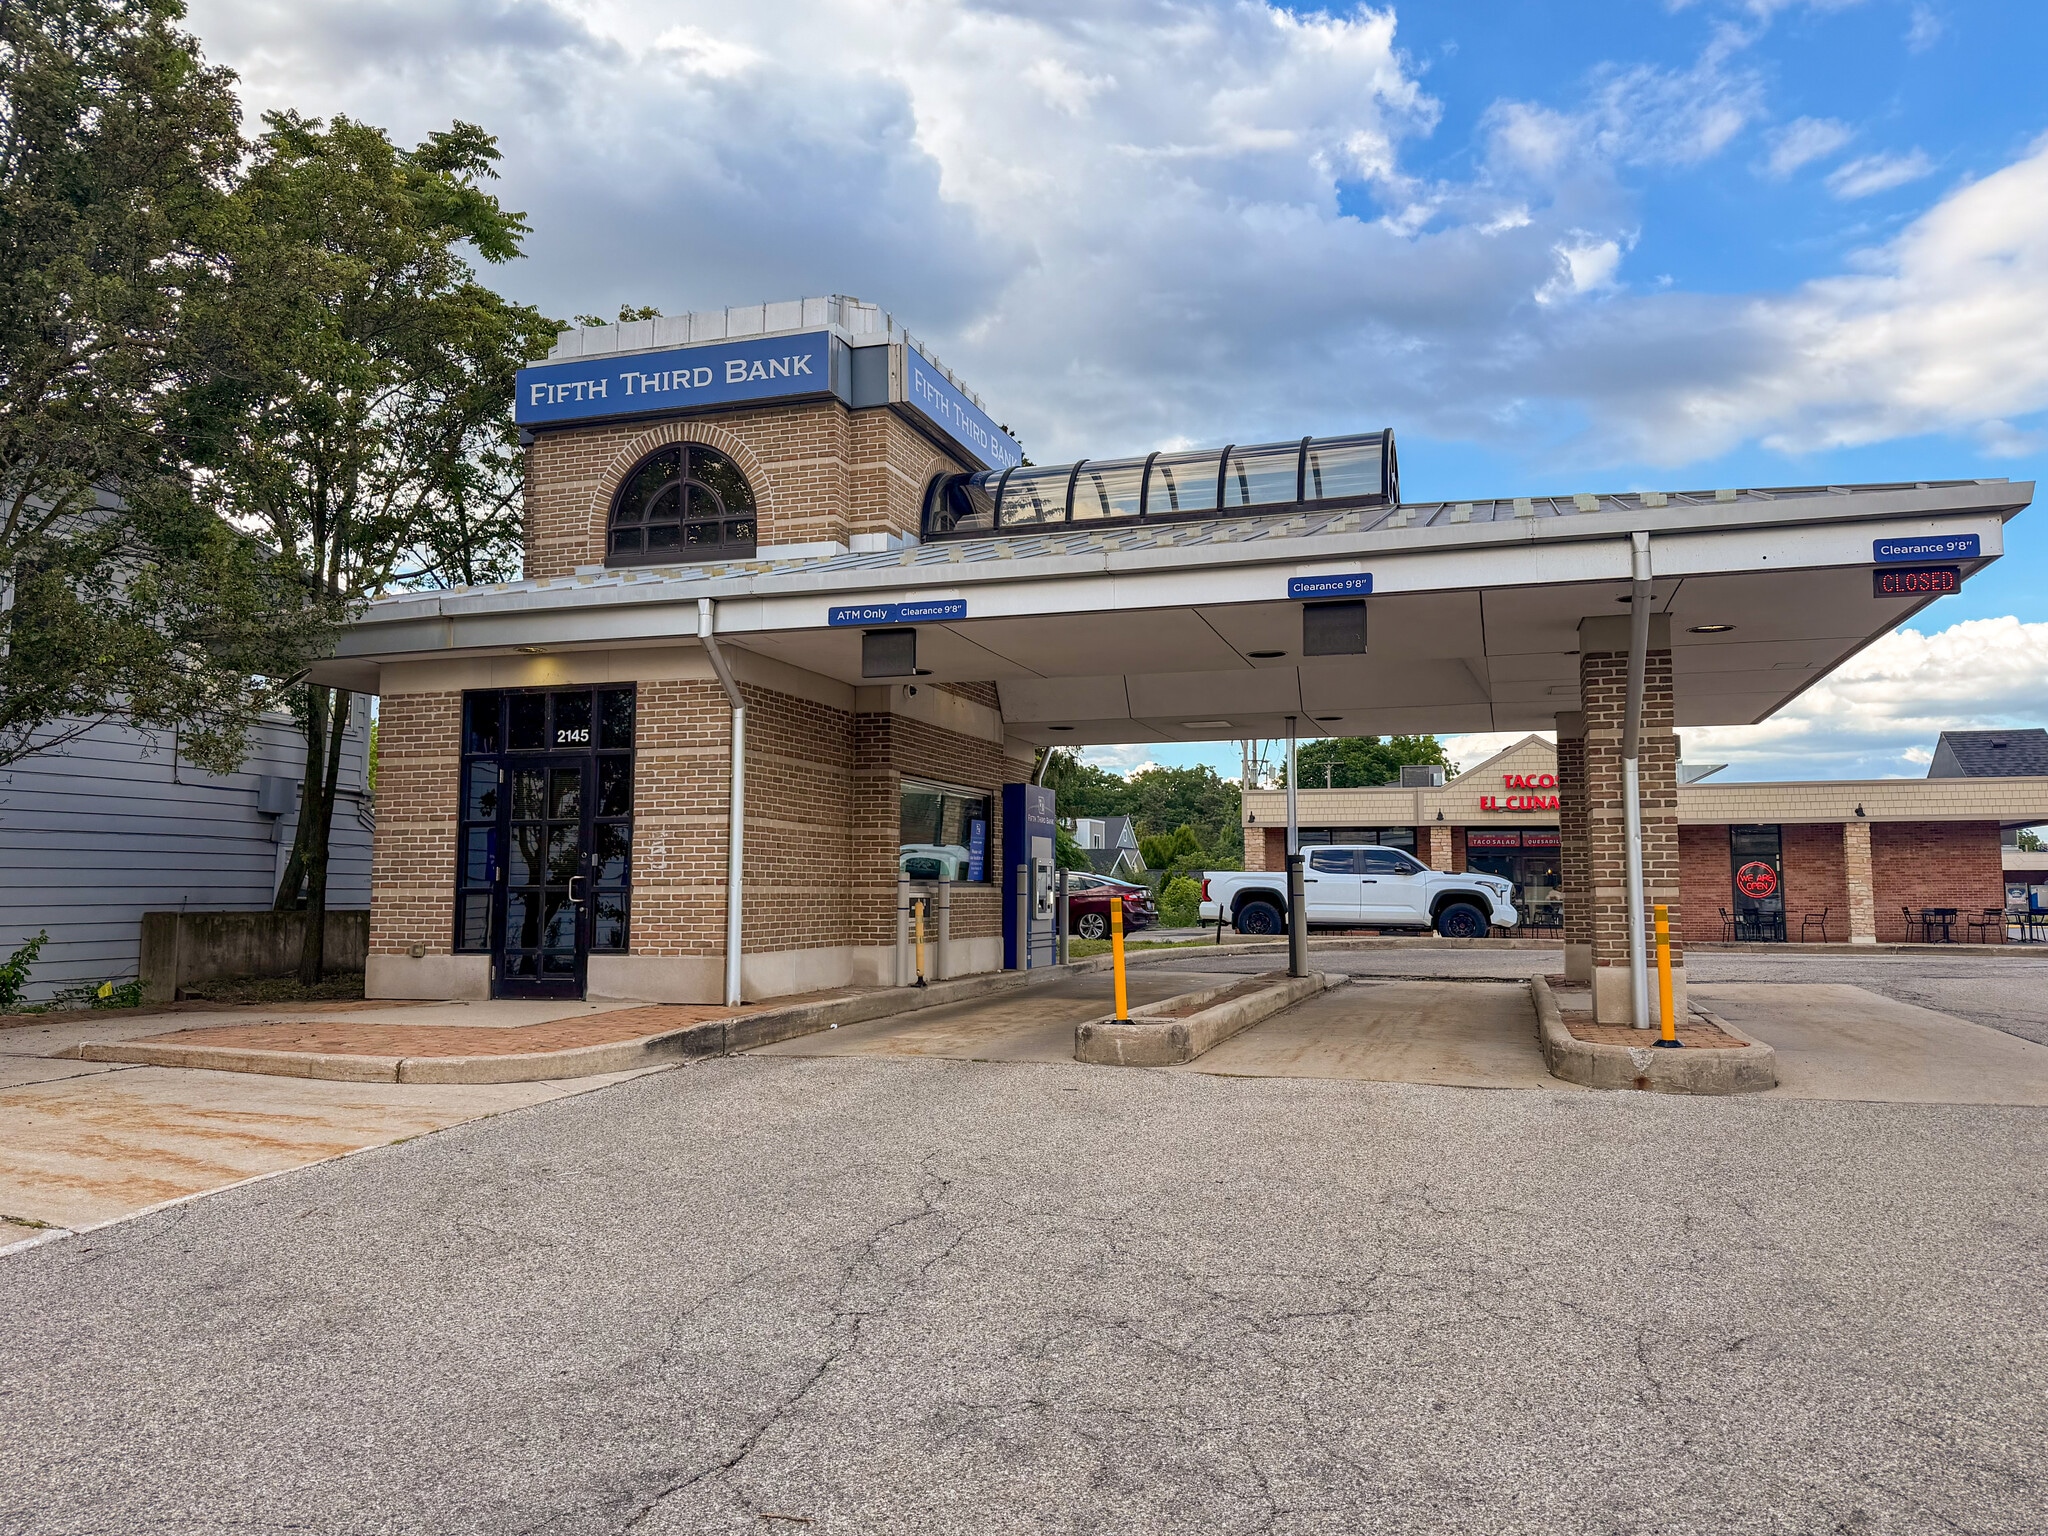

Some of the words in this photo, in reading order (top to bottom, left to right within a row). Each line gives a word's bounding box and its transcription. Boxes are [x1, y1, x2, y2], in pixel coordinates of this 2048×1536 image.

[530, 378, 608, 406] FIFTH
[619, 366, 713, 396] THIRD
[724, 354, 813, 384] BANK
[914, 367, 950, 418] FIFTH
[953, 401, 988, 449] THIRD
[1880, 543, 1944, 555] Clearance
[1946, 540, 1973, 551] 9'8"
[1293, 582, 1344, 592] Clearance
[1345, 579, 1367, 589] 9'8"
[1882, 571, 1955, 593] CLOSED
[837, 610, 861, 621] ATM
[863, 608, 888, 620] Only
[901, 606, 943, 617] Clearance
[944, 605, 962, 614] 9'8"
[557, 729, 589, 743] 2145
[1480, 796, 1500, 810] EL
[1740, 874, 1754, 882] WE
[1757, 873, 1774, 882] ARE
[1746, 882, 1769, 891] OPEN
